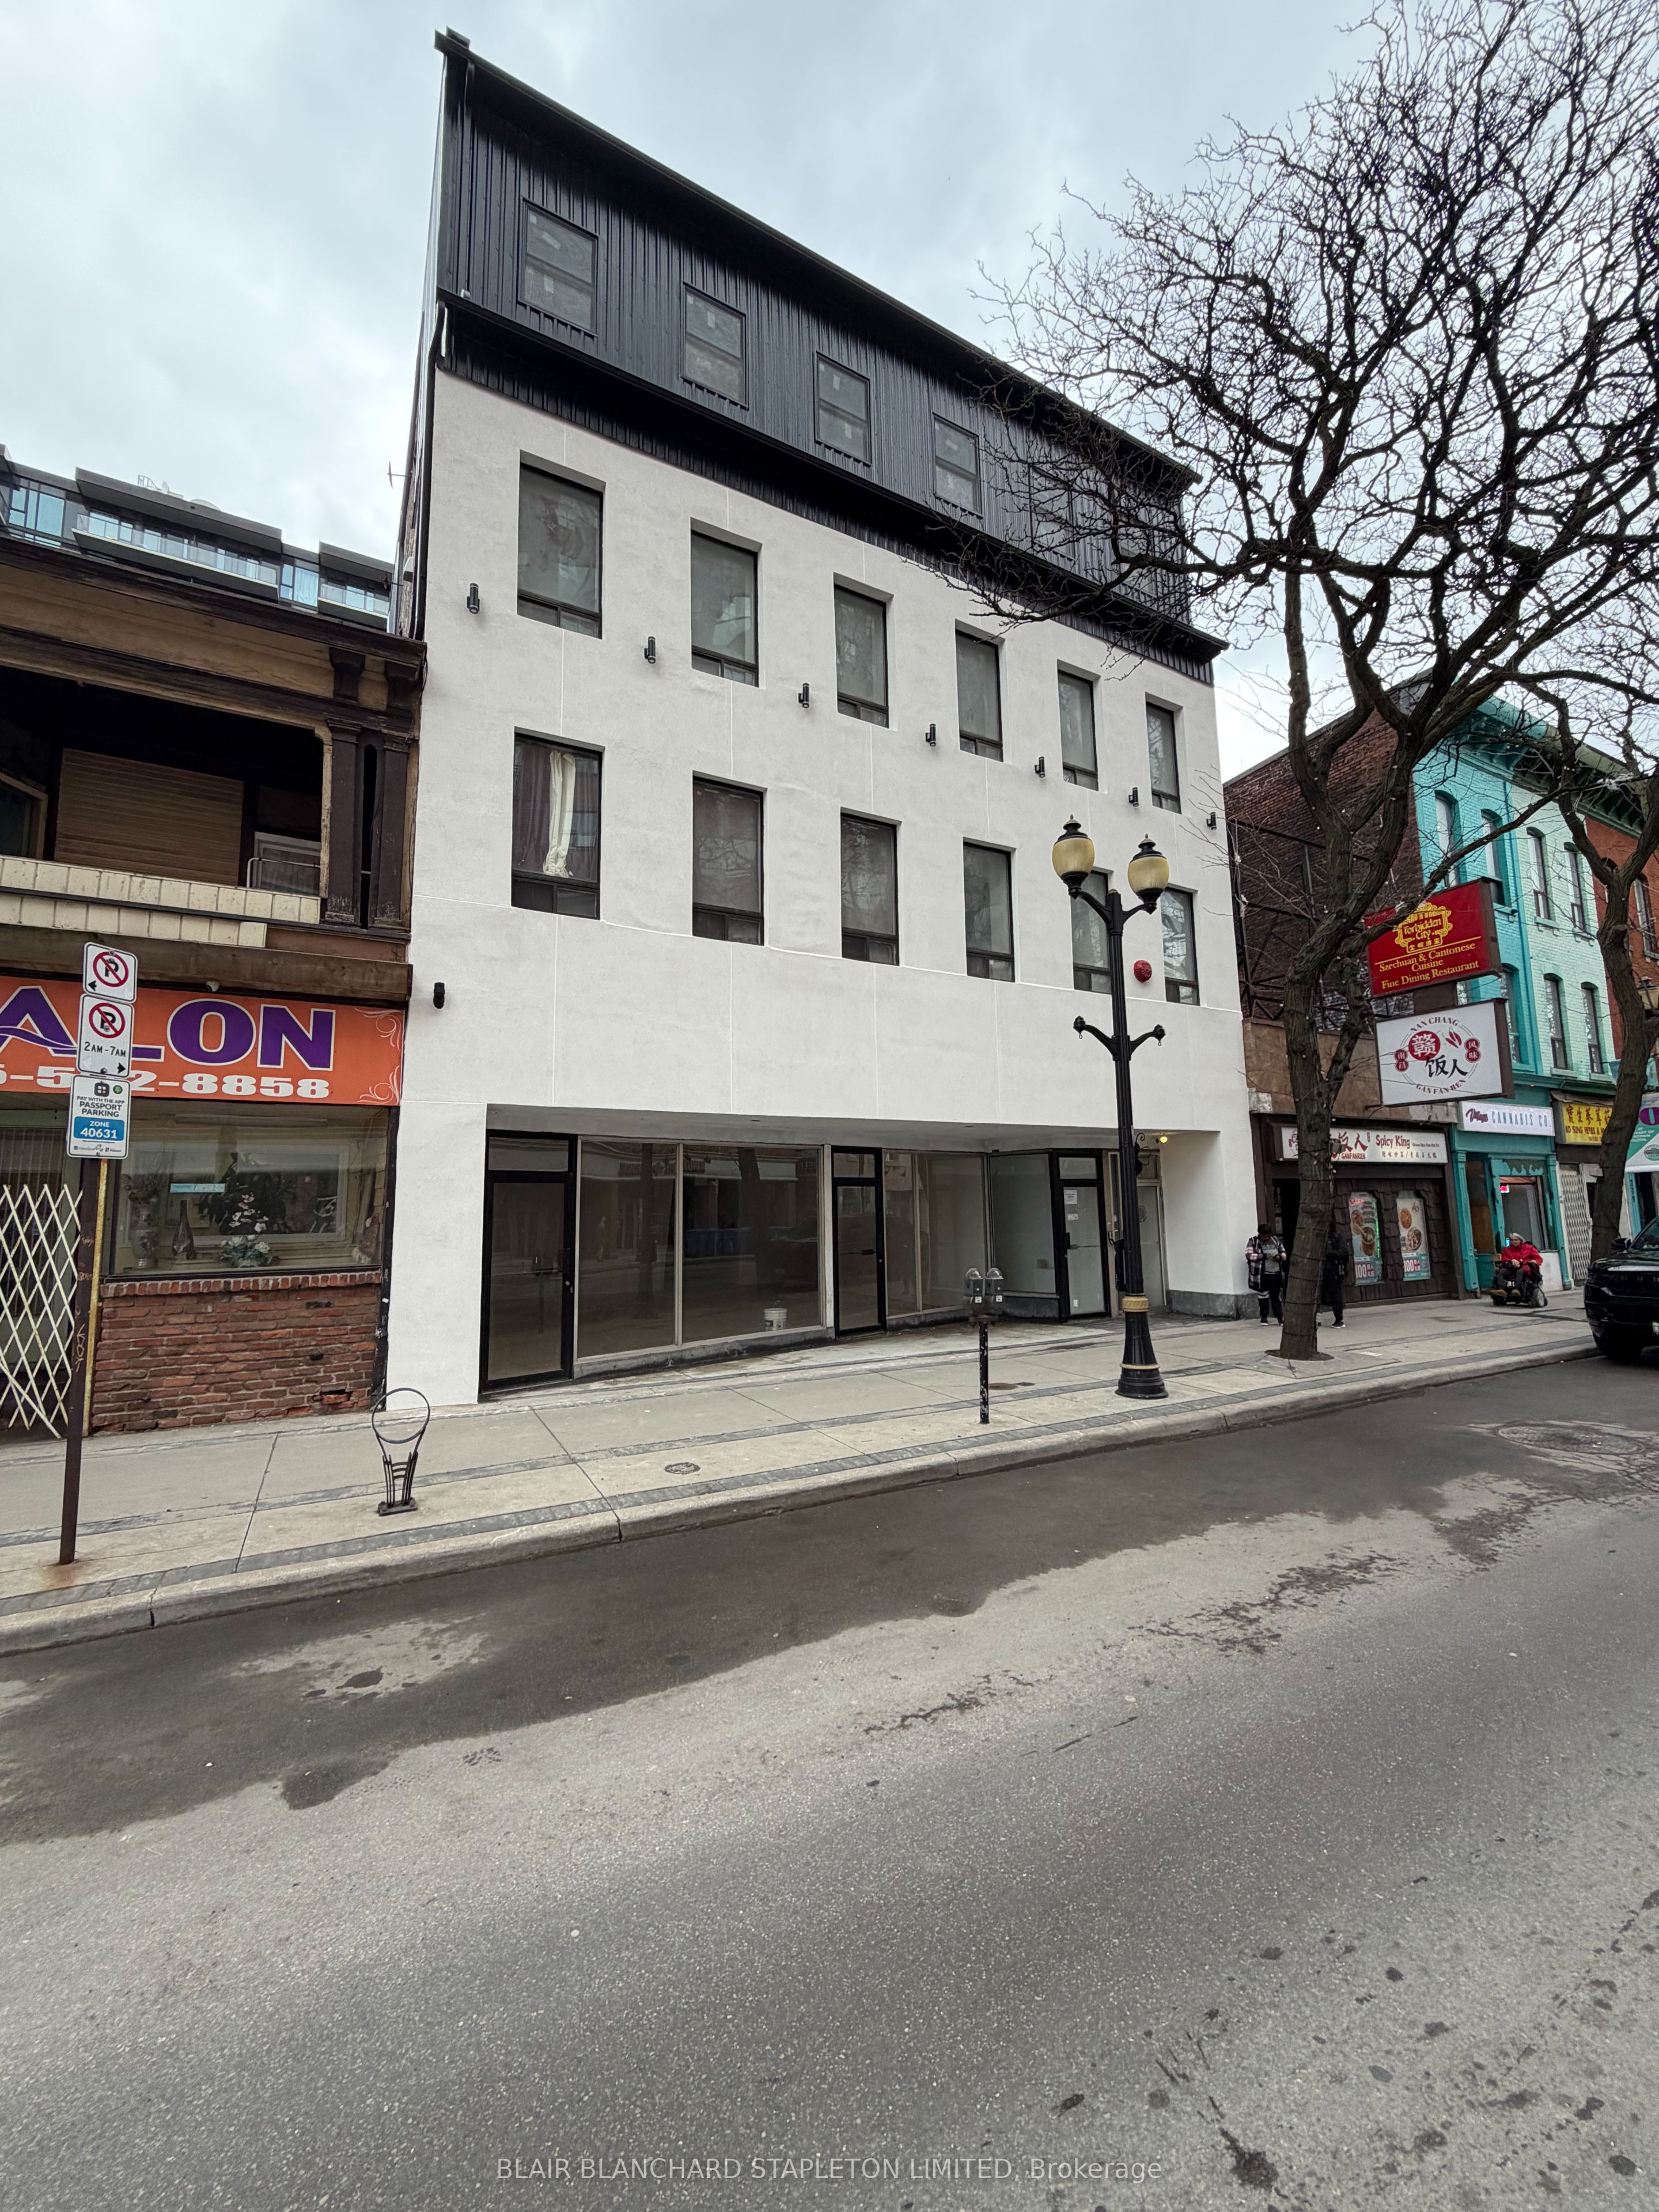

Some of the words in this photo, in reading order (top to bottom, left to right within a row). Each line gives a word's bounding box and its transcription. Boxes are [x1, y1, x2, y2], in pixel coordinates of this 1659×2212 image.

[1404, 918, 1442, 935] Forbidden
[1415, 930, 1431, 941] City
[1379, 956, 1417, 972] Szechuan
[1418, 953, 1426, 962] &
[1428, 942, 1475, 960] Cantonese
[1411, 959, 1444, 972] Cuisine
[1381, 979, 1400, 990] Fine
[1401, 972, 1430, 986] Dining
[1431, 960, 1479, 978] Restaurant
[1410, 1020, 1427, 1032] NAN
[1429, 1017, 1460, 1027] CHANG
[1416, 1084, 1431, 1094] GAN
[79, 1101, 122, 1111] PASSPORT
[81, 1108, 119, 1118] PARKING
[1492, 1111, 1533, 1126] CANNABIS
[80, 1127, 118, 1139] 40631
[1376, 1134, 1394, 1147] Spicy
[1395, 1135, 1410, 1149] King
